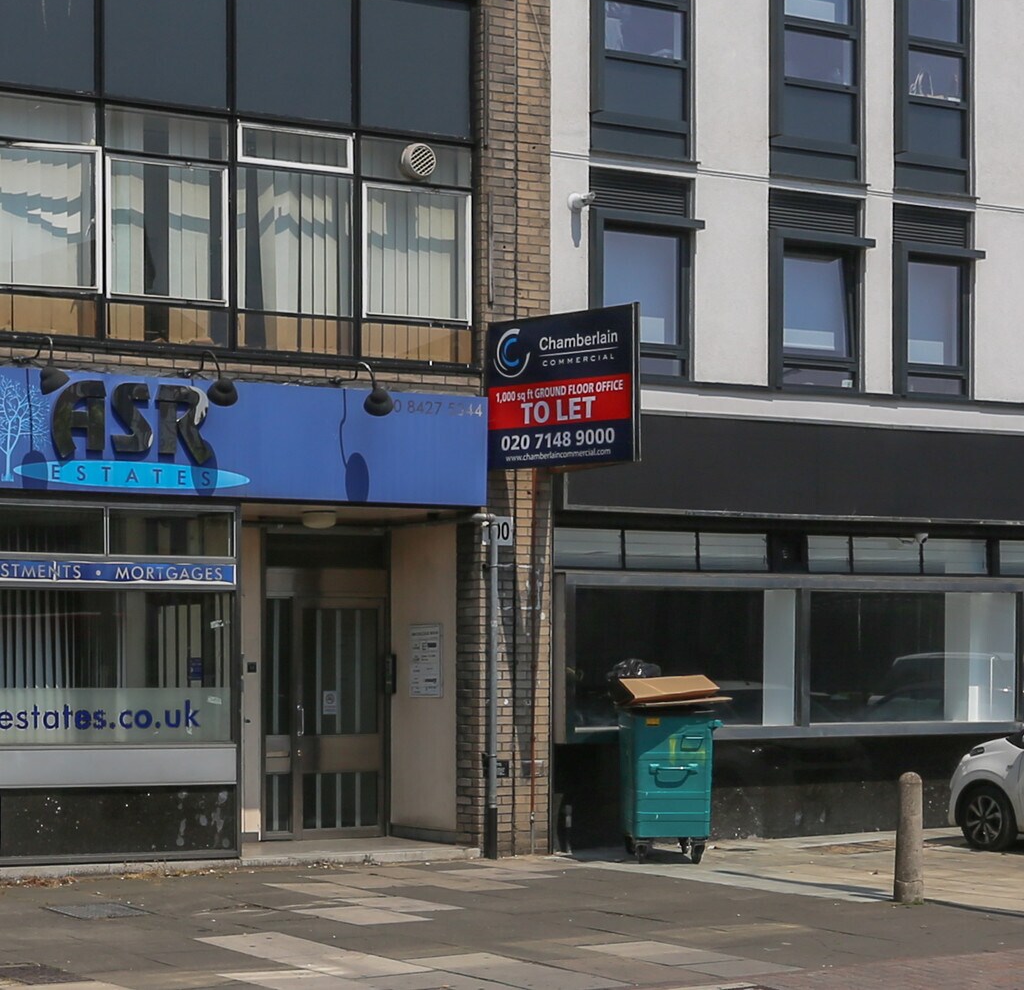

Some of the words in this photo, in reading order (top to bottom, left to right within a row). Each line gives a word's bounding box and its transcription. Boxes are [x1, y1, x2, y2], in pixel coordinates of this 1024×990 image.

[539, 329, 618, 351] Chamberlain
[542, 353, 615, 367] COMMERCIAL
[495, 391, 516, 403] 1,000
[517, 393, 526, 403] sq
[527, 390, 534, 400] ft
[534, 385, 566, 399] GROUND
[568, 383, 595, 395] FLOOR
[595, 379, 624, 393] OFFICE
[521, 400, 550, 425] TO
[556, 396, 596, 421] LET
[53, 380, 214, 465] ASR
[501, 434, 531, 451] 020
[534, 431, 572, 449] 7148
[575, 427, 616, 446] 9000
[505, 447, 612, 462] www.chamberlaincommercial.com
[52, 464, 211, 487] ESTATES
[115, 566, 223, 581] MORTGAGES
